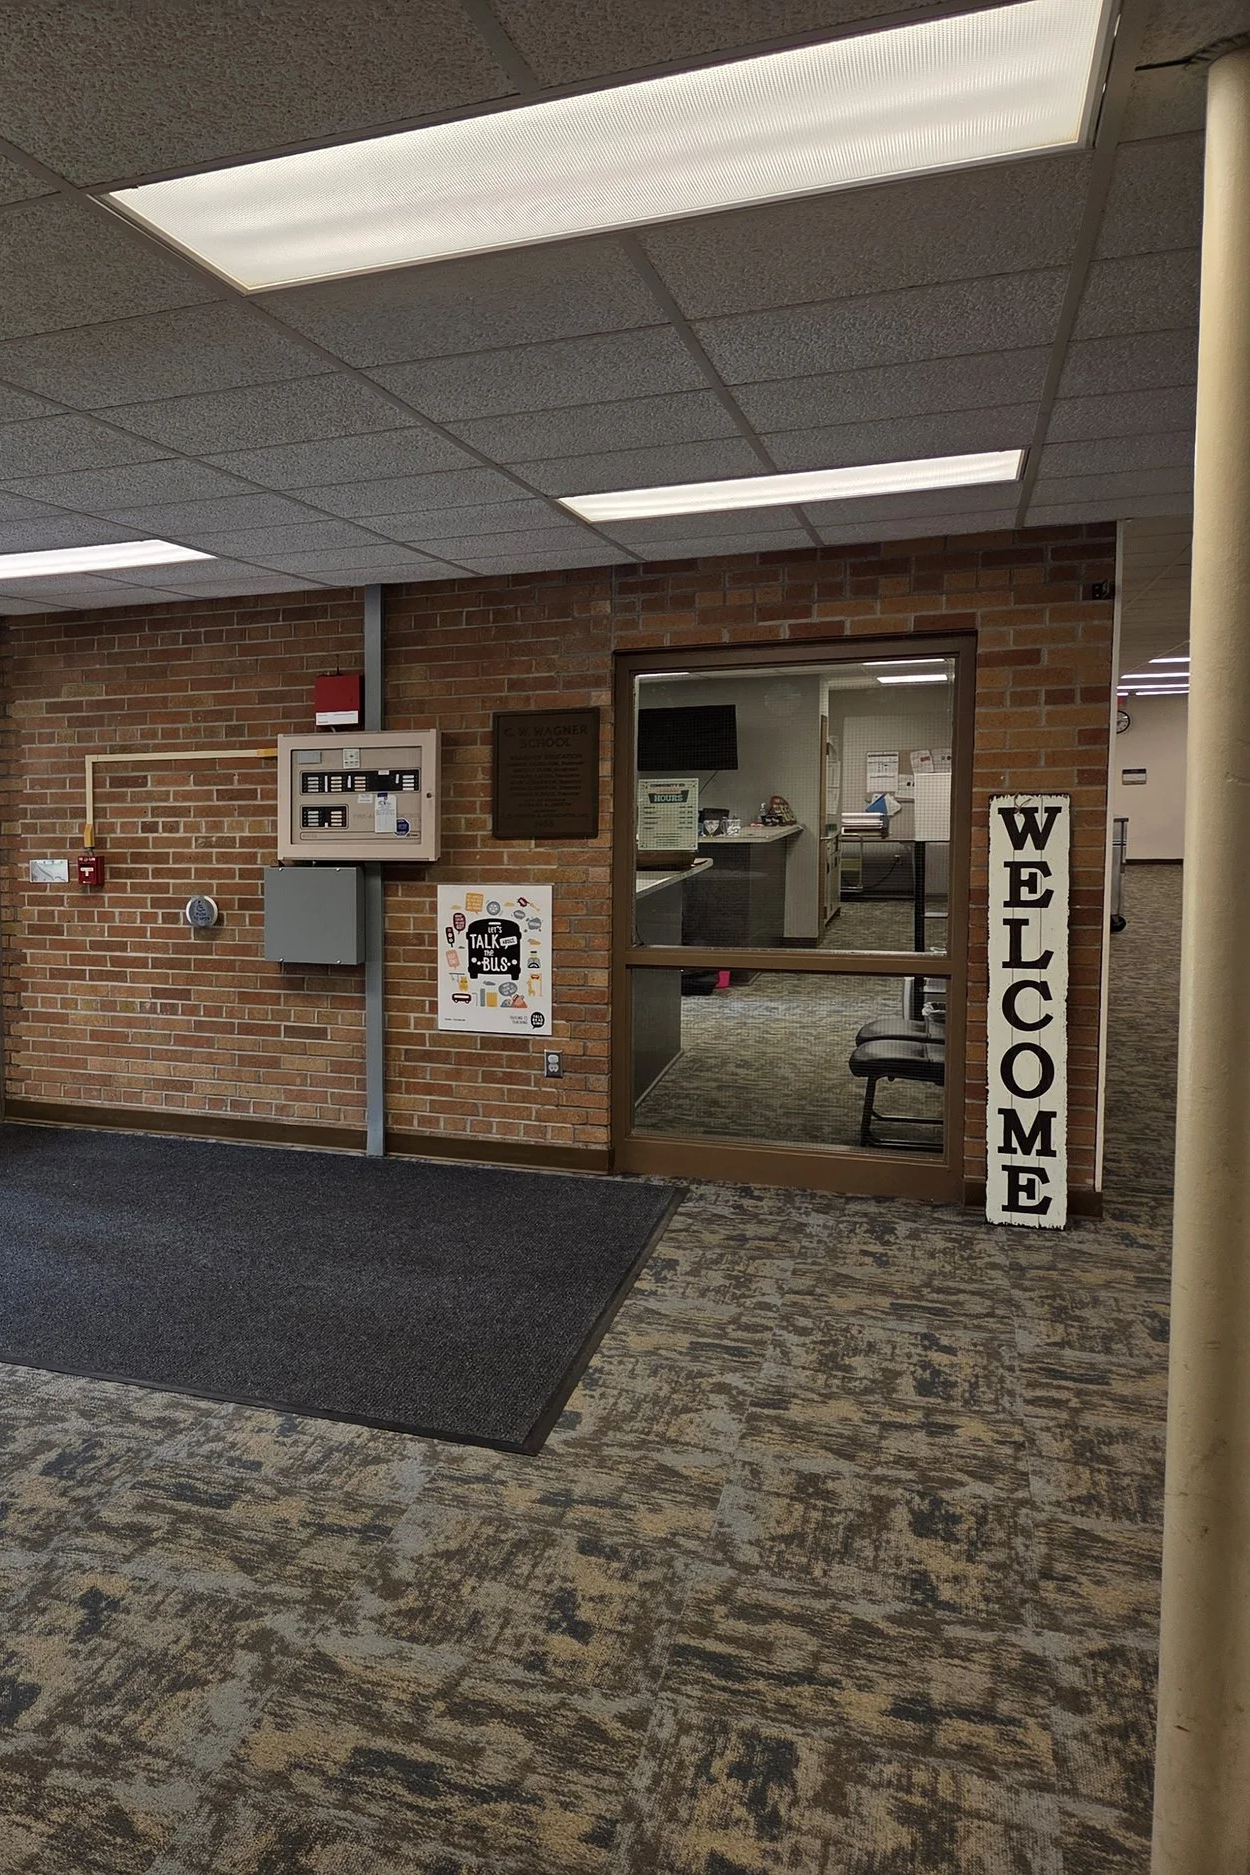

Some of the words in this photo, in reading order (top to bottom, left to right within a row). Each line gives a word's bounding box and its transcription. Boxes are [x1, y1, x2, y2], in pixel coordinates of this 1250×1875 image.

[533, 724, 588, 736] WAGNER
[519, 737, 572, 748] SCHOOL
[469, 934, 500, 949] TALK
[483, 957, 508, 972] BUS
[997, 806, 1062, 1216] WELCOME
